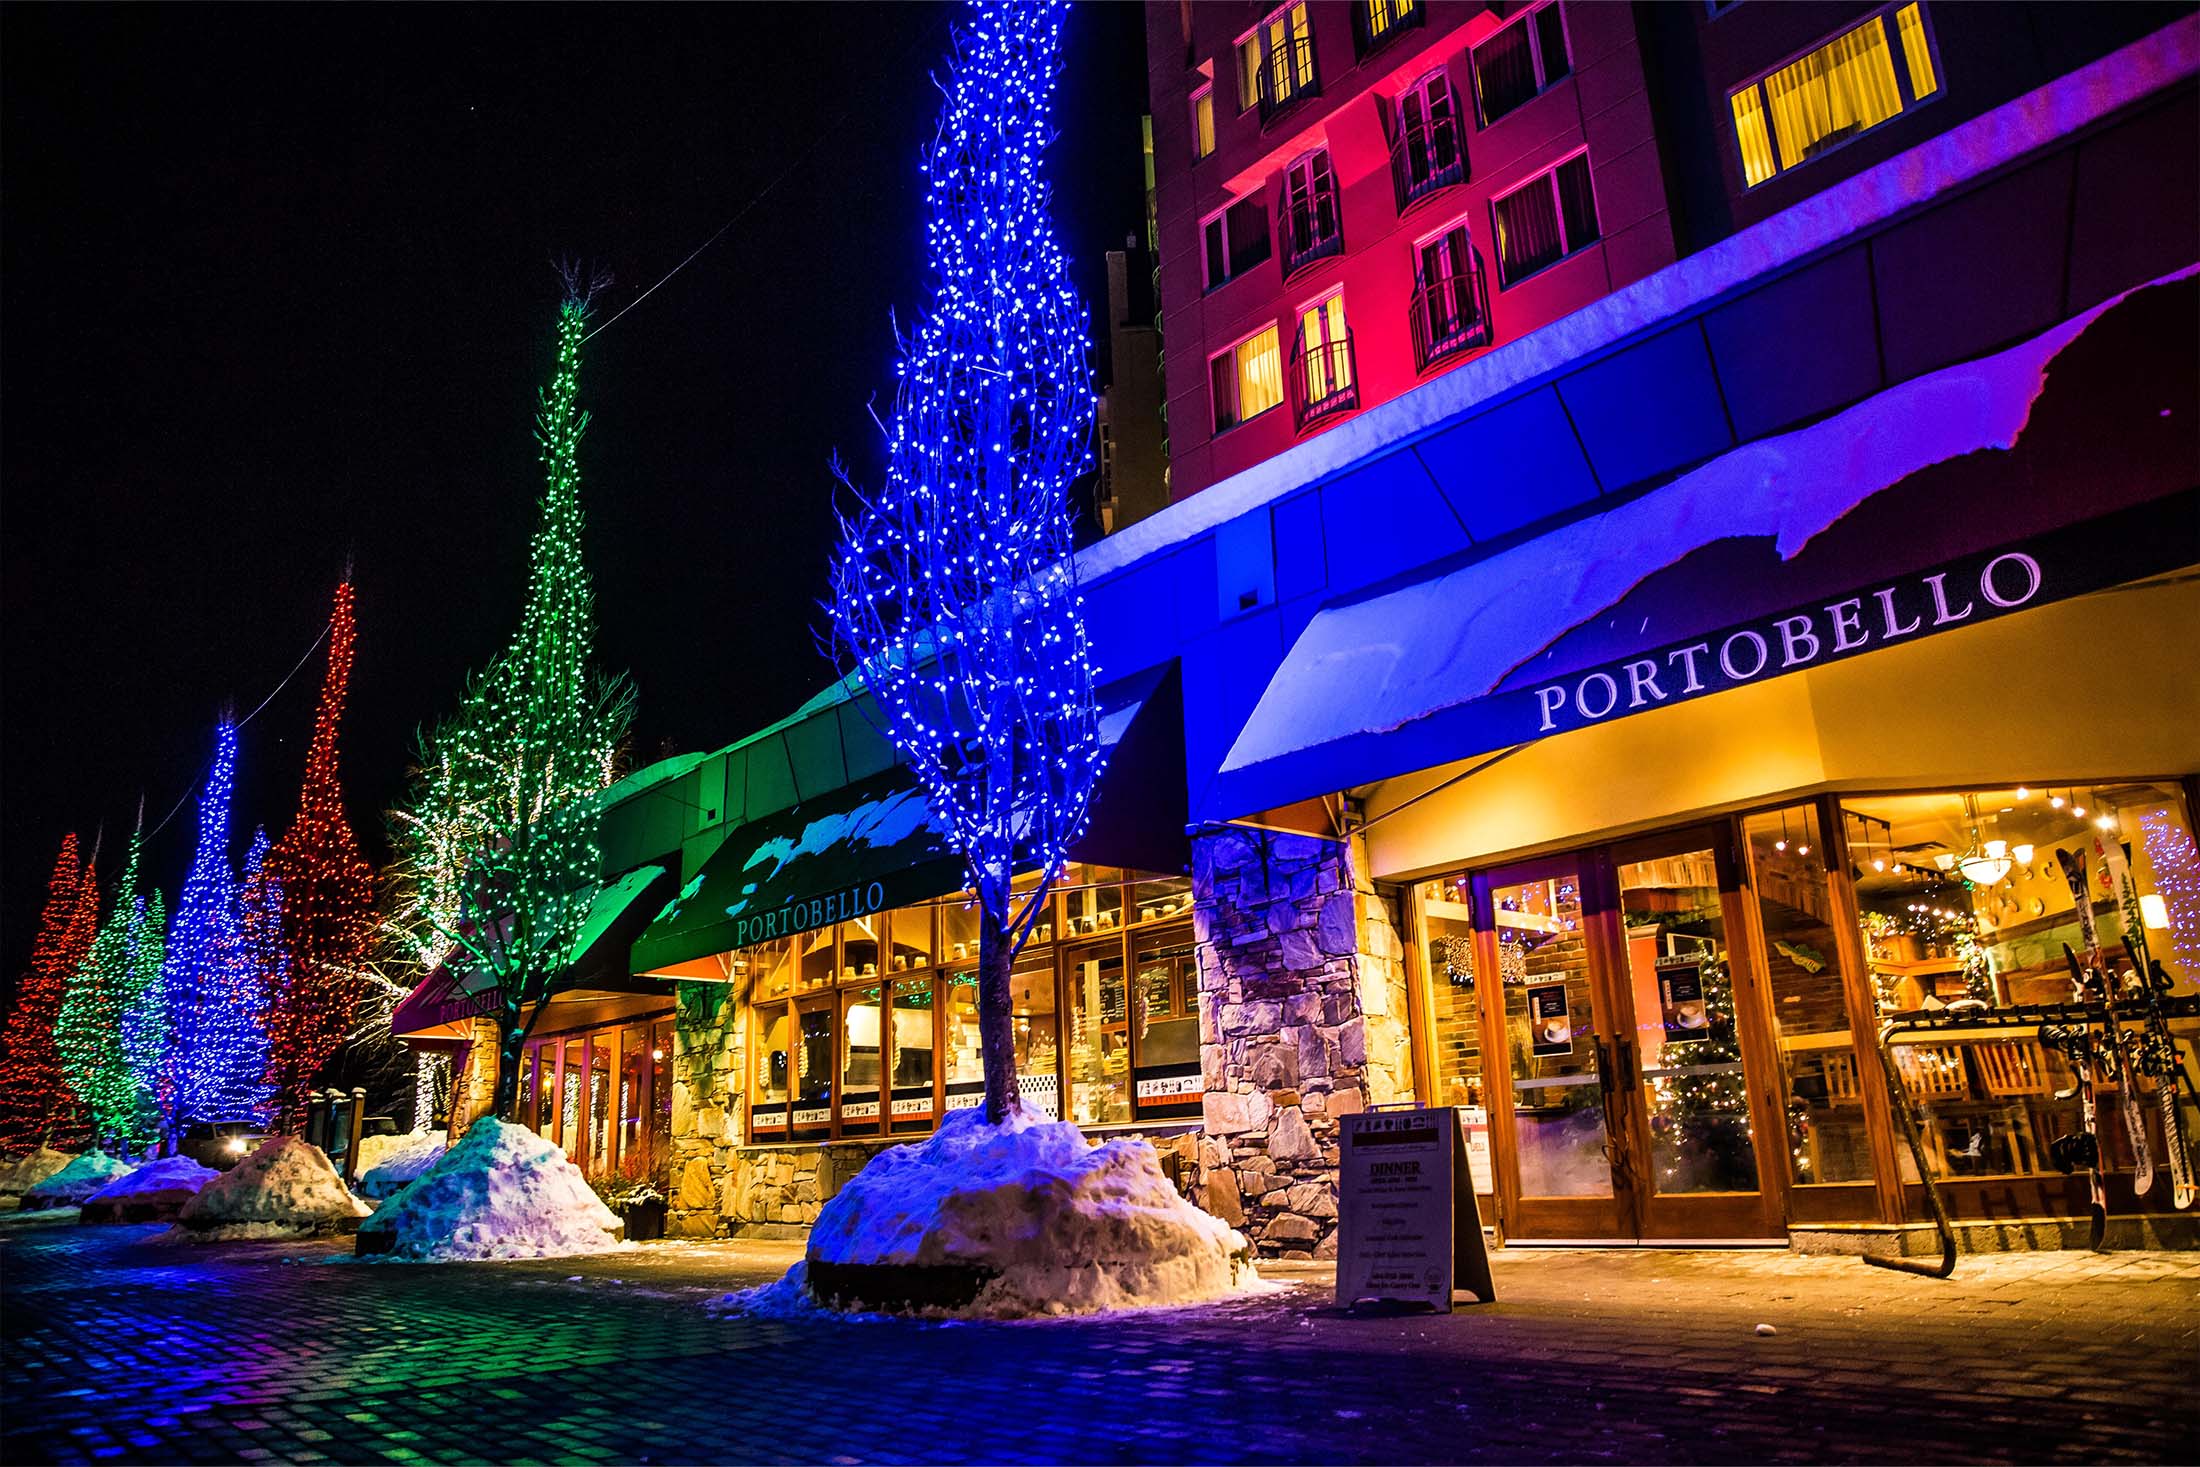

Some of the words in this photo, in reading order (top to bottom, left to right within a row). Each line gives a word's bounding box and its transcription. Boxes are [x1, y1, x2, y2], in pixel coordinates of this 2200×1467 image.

[1534, 551, 2042, 733] PORTOBELLO
[737, 881, 884, 946] PORTOBELLO
[439, 989, 504, 1023] PORTOBELL
[1369, 1161, 1422, 1175] DINNER
